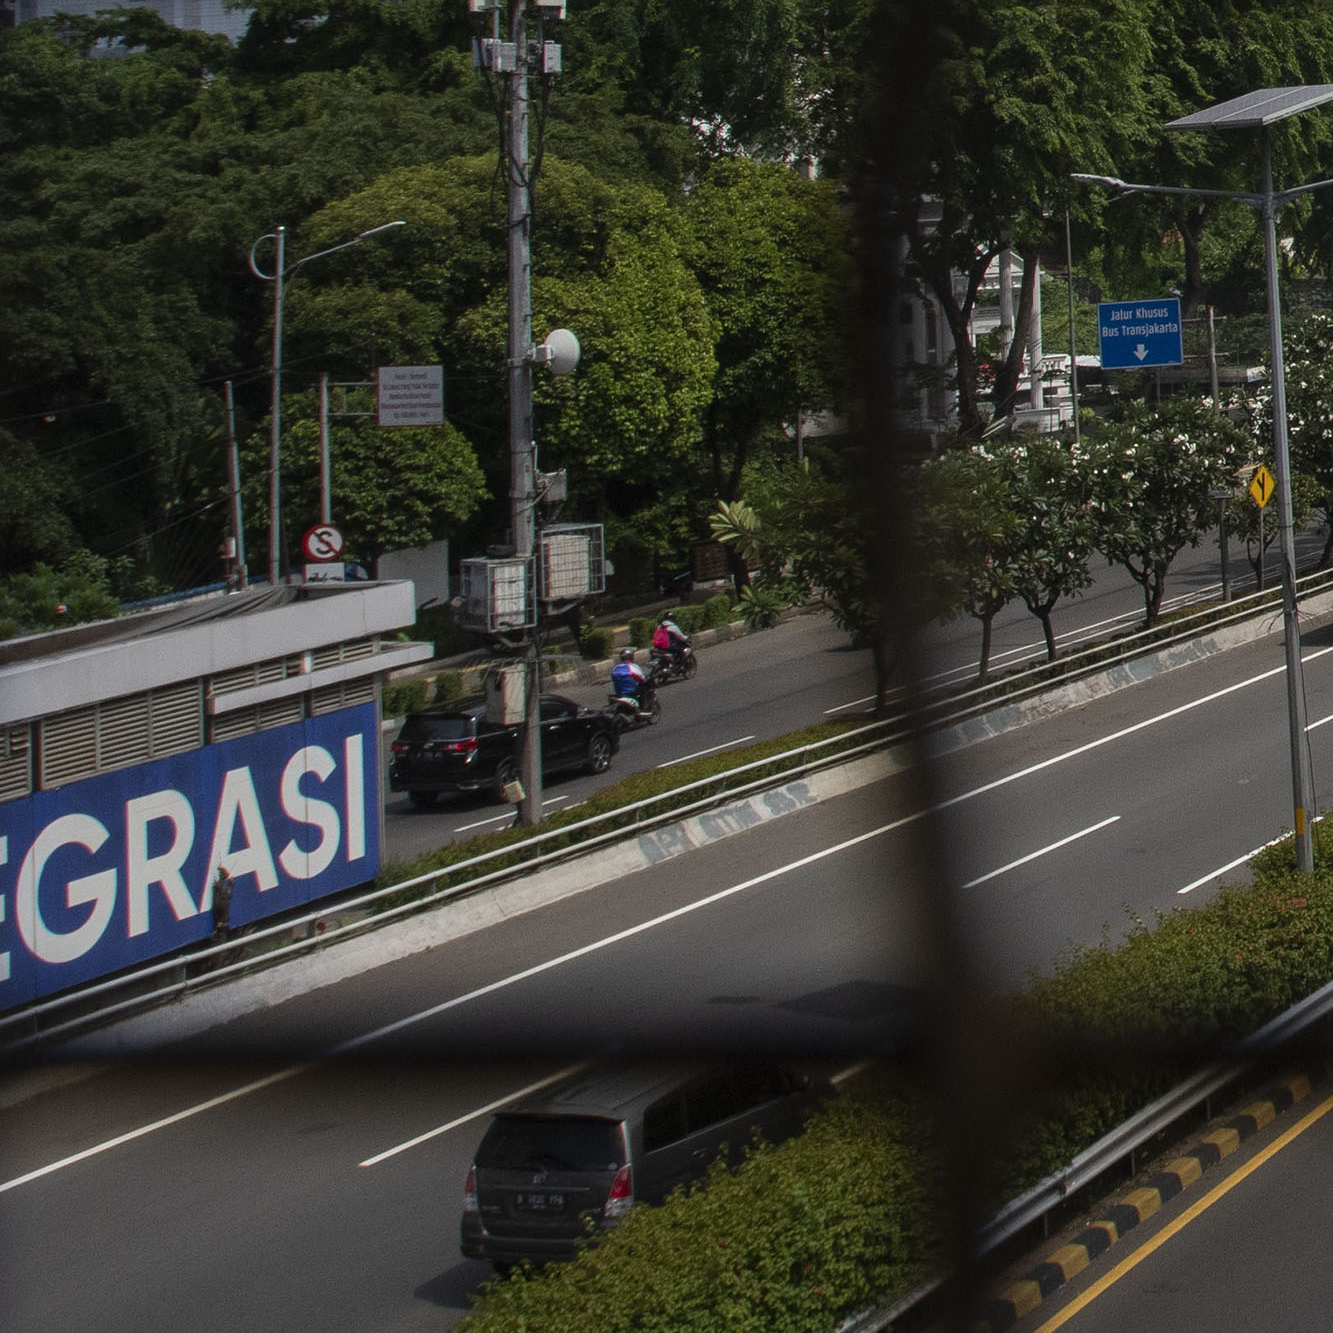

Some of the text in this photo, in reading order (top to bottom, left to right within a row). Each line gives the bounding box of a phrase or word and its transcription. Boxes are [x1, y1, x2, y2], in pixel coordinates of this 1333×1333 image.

[1110, 307, 1168, 321] Jalur Khusus
[1102, 322, 1178, 337] Bus Transjakarta
